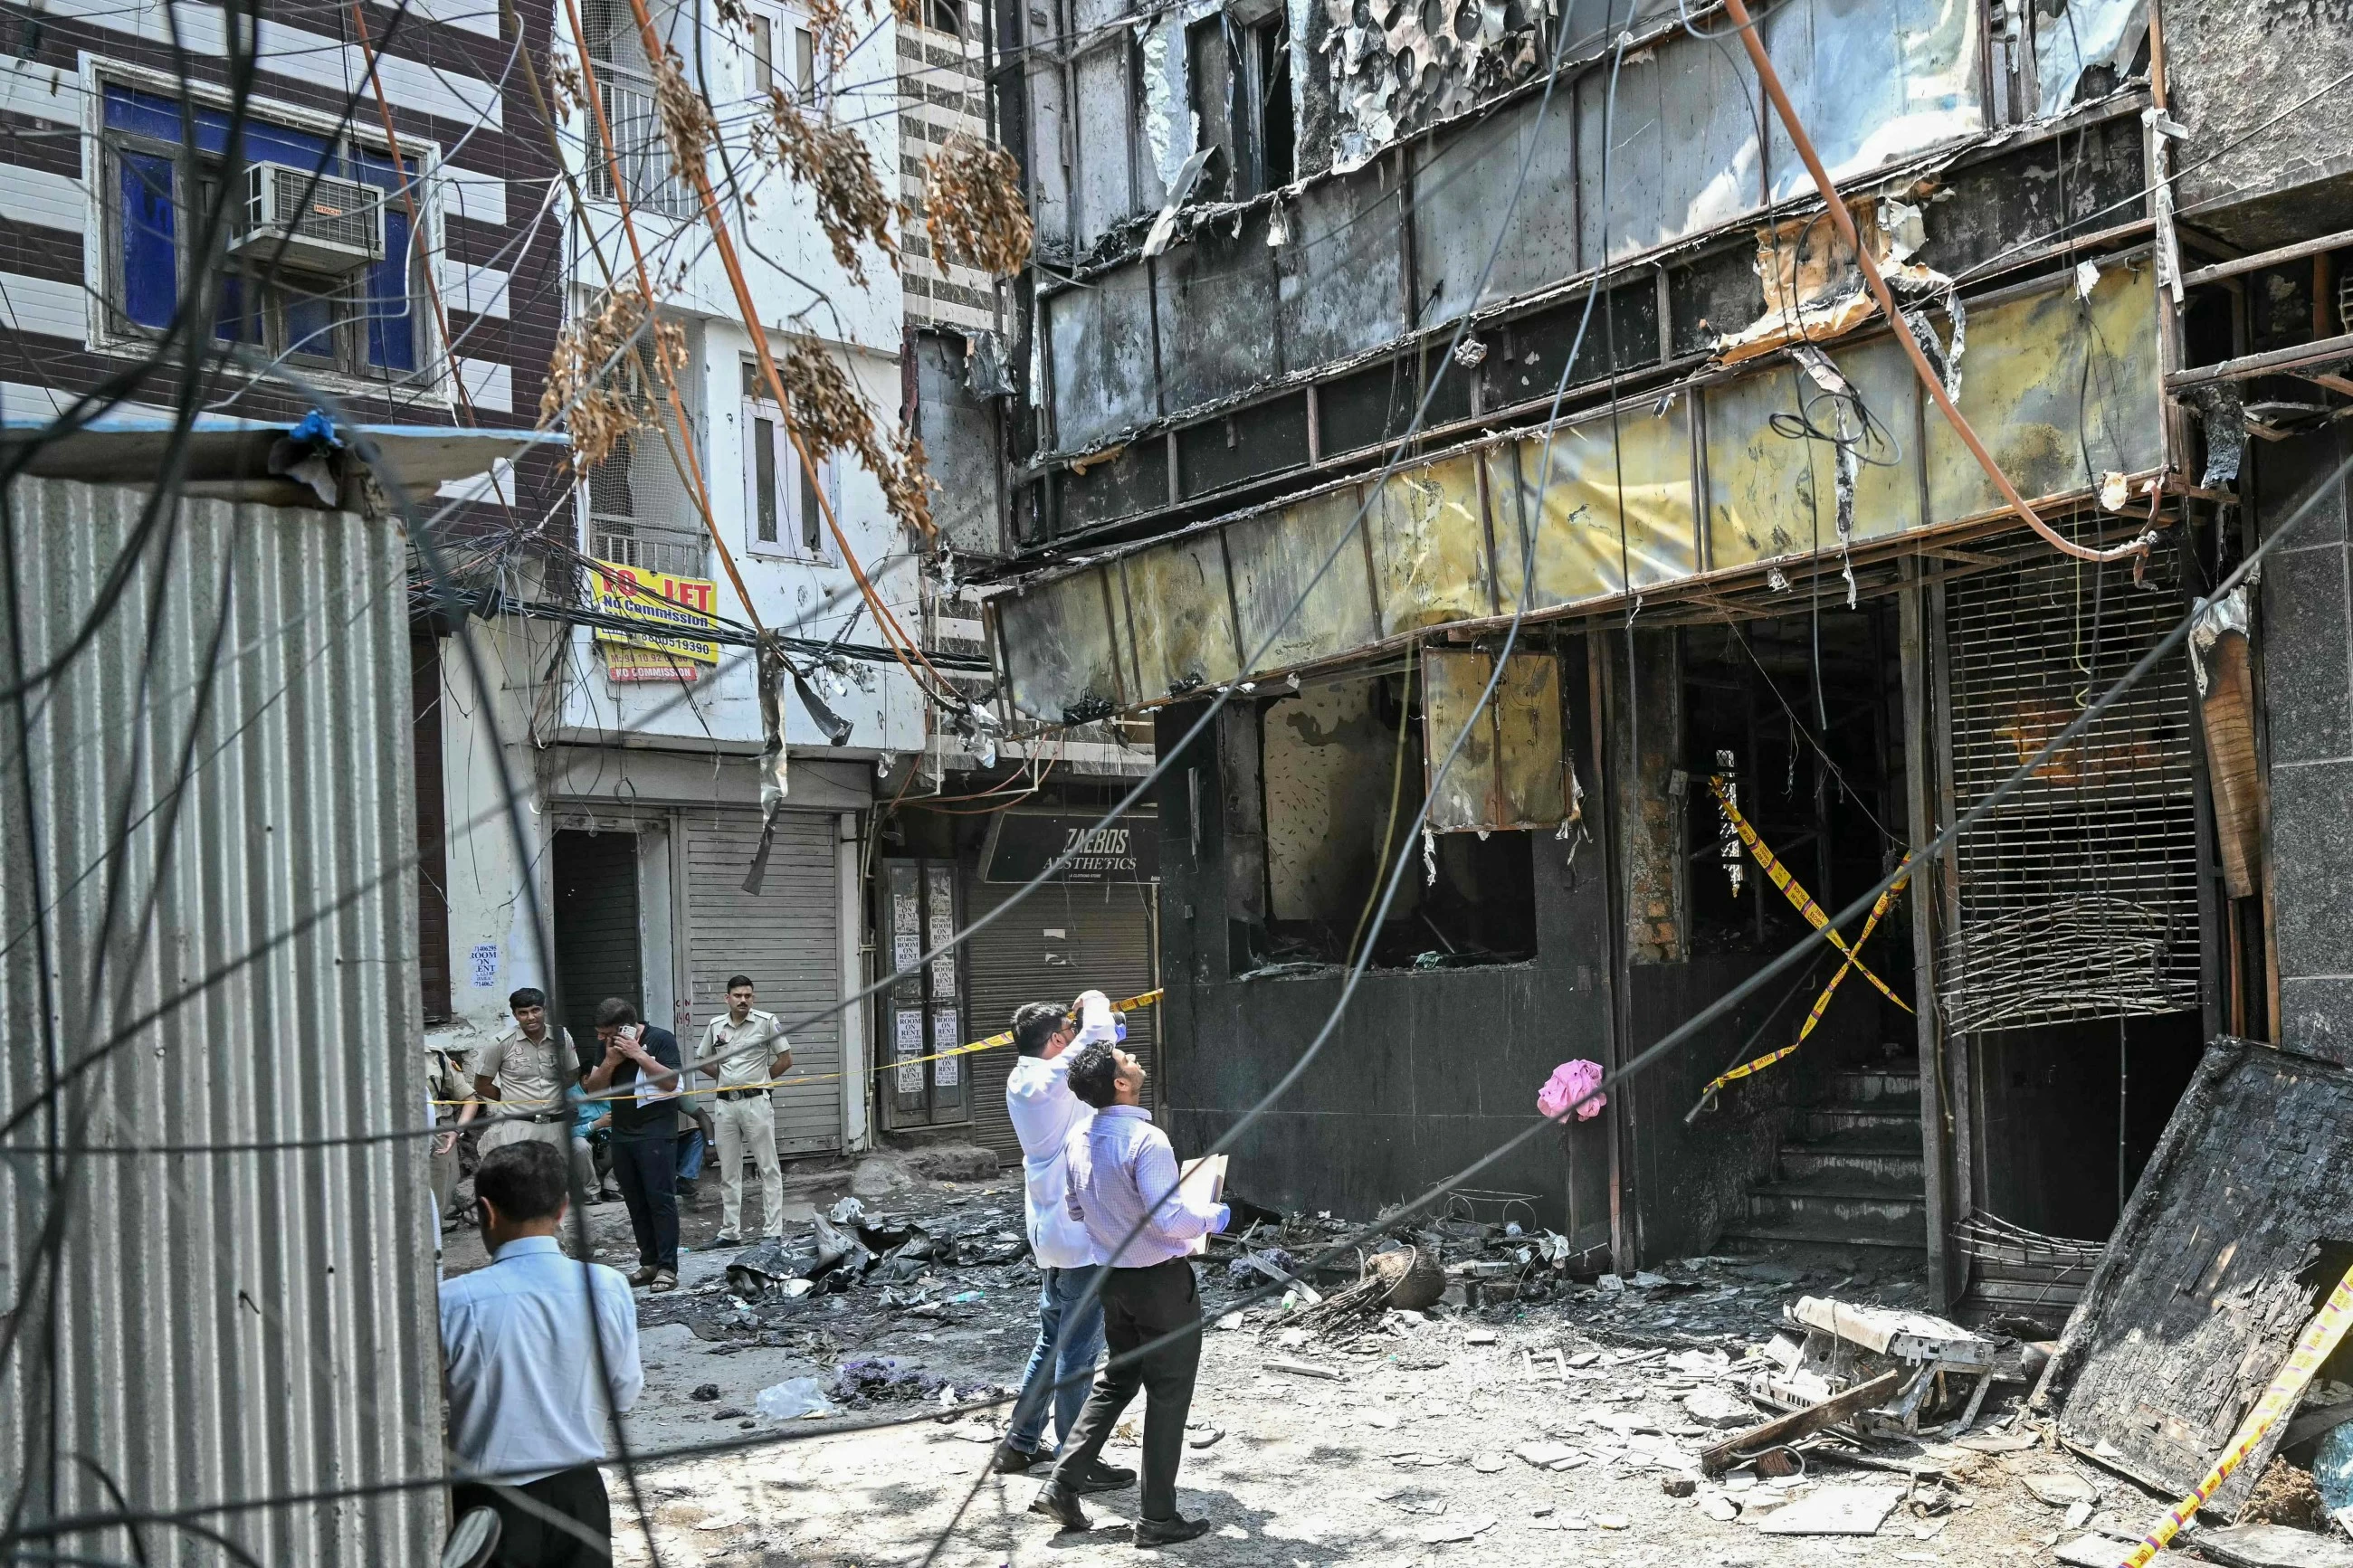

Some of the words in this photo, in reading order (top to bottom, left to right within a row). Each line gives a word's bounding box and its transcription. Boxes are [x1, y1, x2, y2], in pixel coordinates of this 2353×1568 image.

[315, 205, 341, 215] HITACHI
[663, 578, 712, 613] LET
[604, 594, 622, 609] No
[624, 599, 709, 627] Commission
[615, 668, 629, 678] NO
[632, 667, 691, 677] COMMISSION
[1062, 827, 1129, 855] ZAEBOS
[1042, 856, 1138, 870] AESTHETICS
[476, 965, 496, 973] ENT
